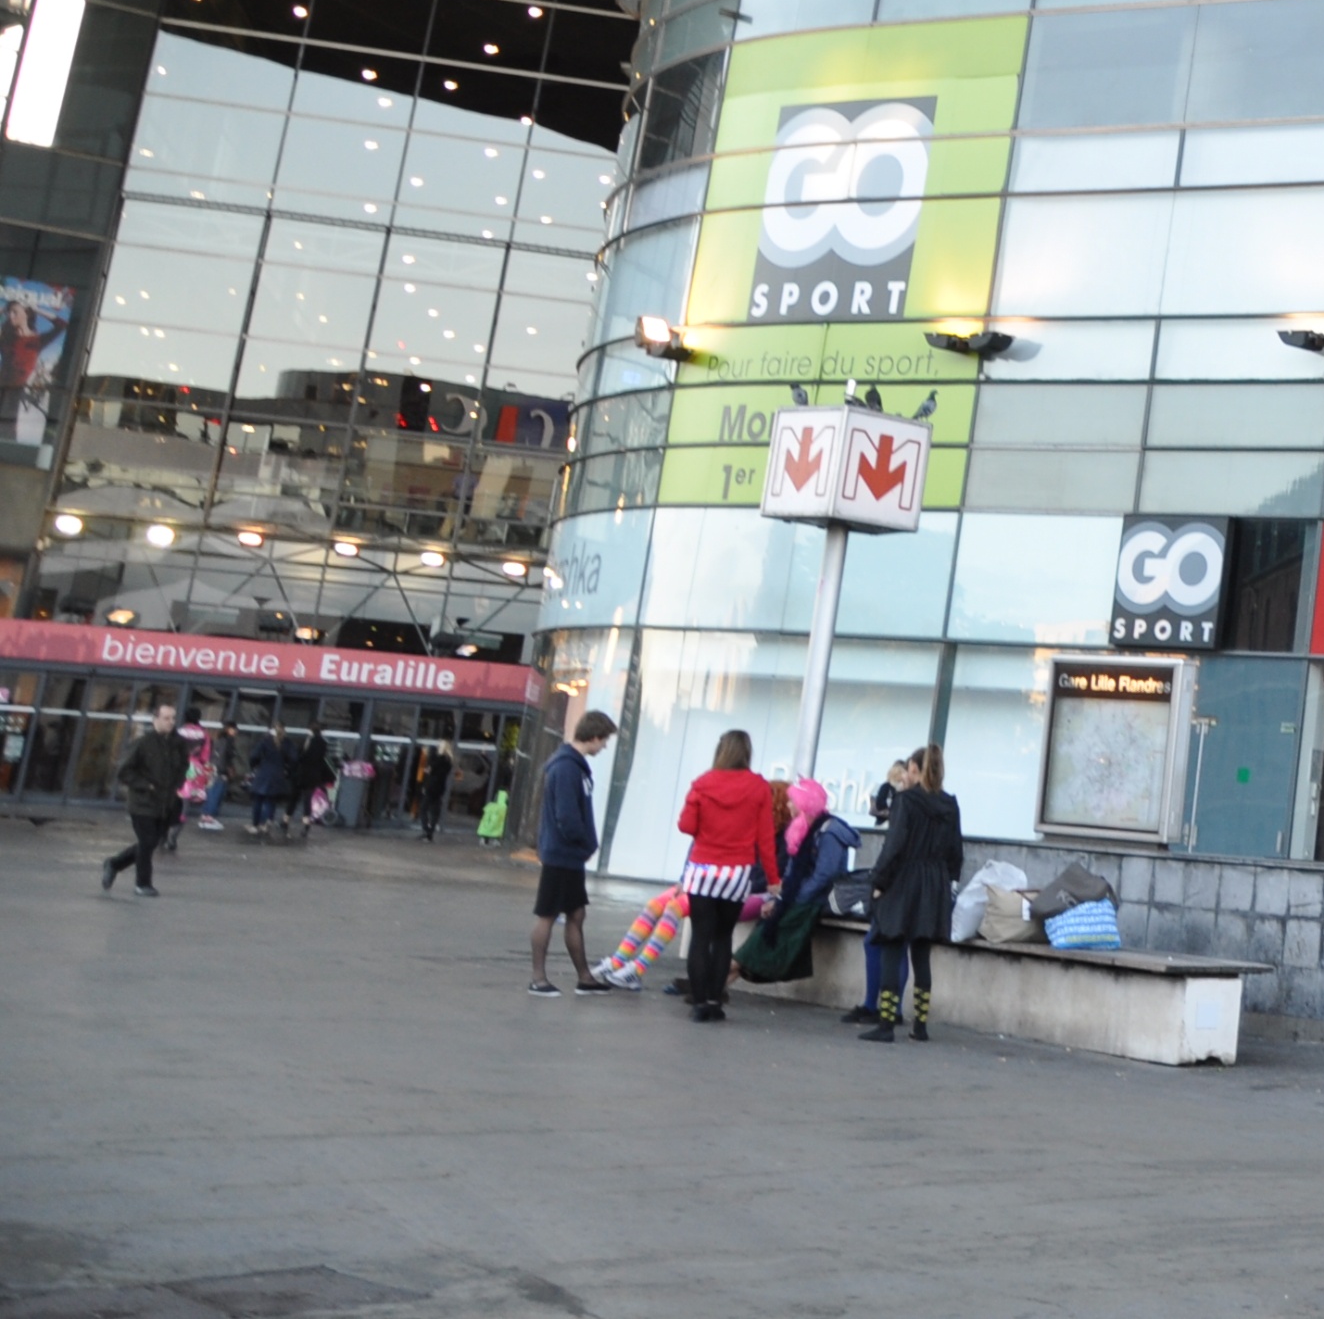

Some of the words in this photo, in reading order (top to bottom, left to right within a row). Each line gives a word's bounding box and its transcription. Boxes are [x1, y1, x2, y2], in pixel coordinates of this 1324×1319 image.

[762, 118, 929, 253] GO
[750, 280, 907, 318] SPORT
[706, 355, 753, 381] Pour
[759, 350, 813, 377] faire
[821, 350, 855, 376] du
[1116, 530, 1224, 607] GO
[1112, 617, 1215, 644] SPORT
[102, 633, 280, 676] bienvenue
[319, 653, 457, 692] Euralille
[1058, 672, 1088, 691] Gare
[1090, 674, 1117, 693] Lille
[1118, 675, 1172, 695] Flandres
